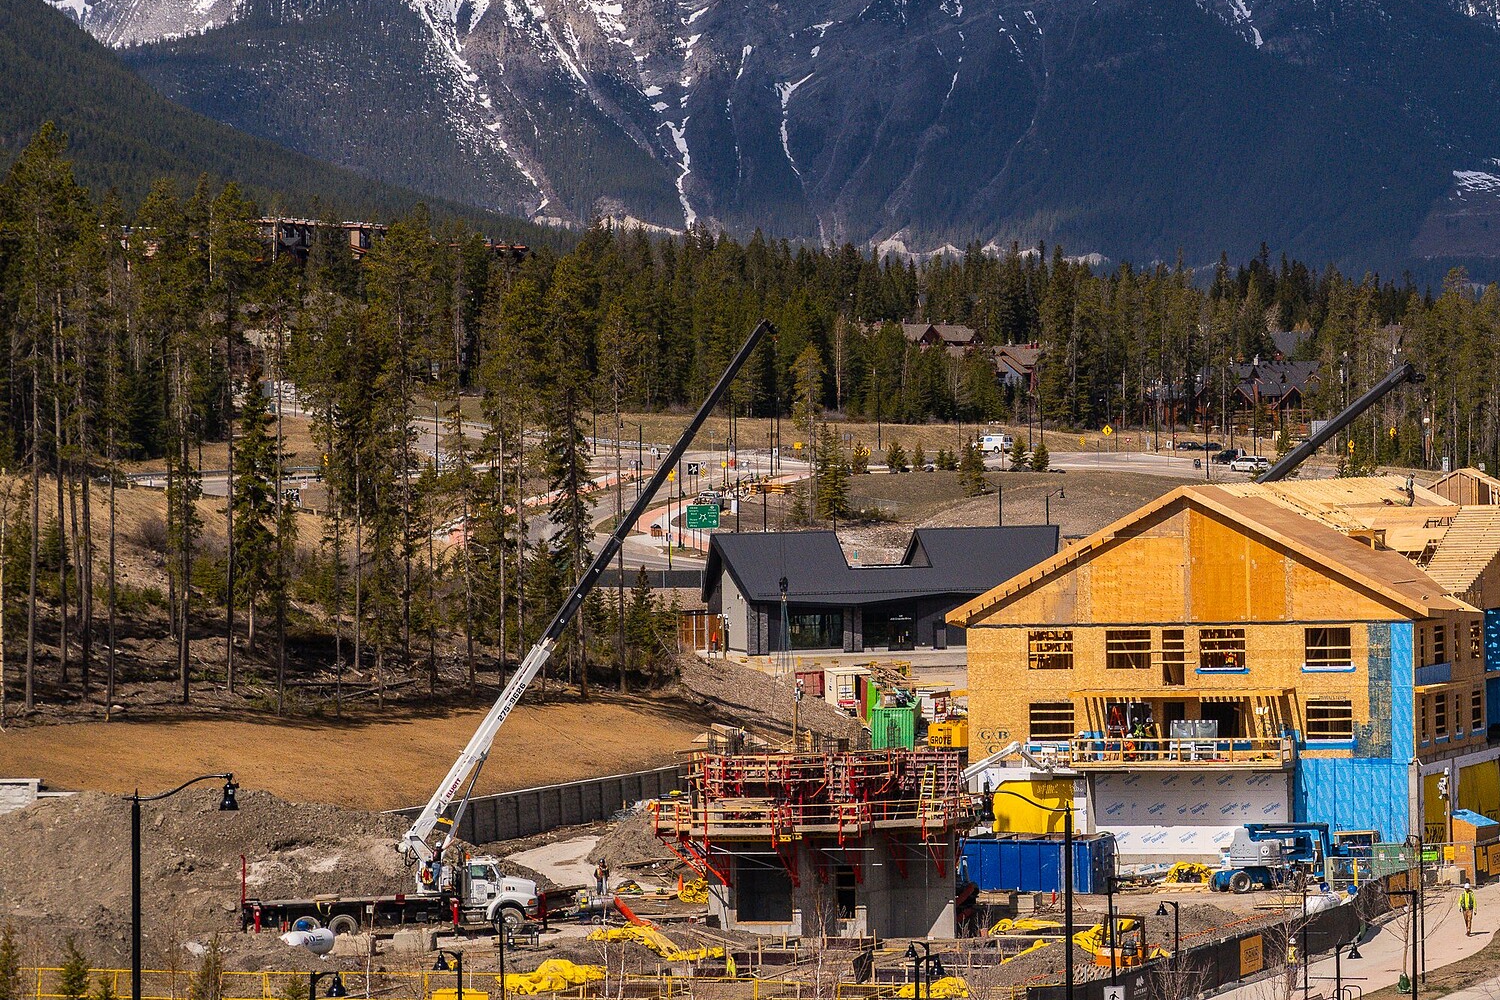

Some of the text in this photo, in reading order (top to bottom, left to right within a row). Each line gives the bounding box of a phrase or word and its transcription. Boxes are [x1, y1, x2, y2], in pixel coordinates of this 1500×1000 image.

[497, 682, 526, 722] 275-9626
[930, 735, 952, 745] GROTE
[445, 777, 461, 799] ELLIOTT
